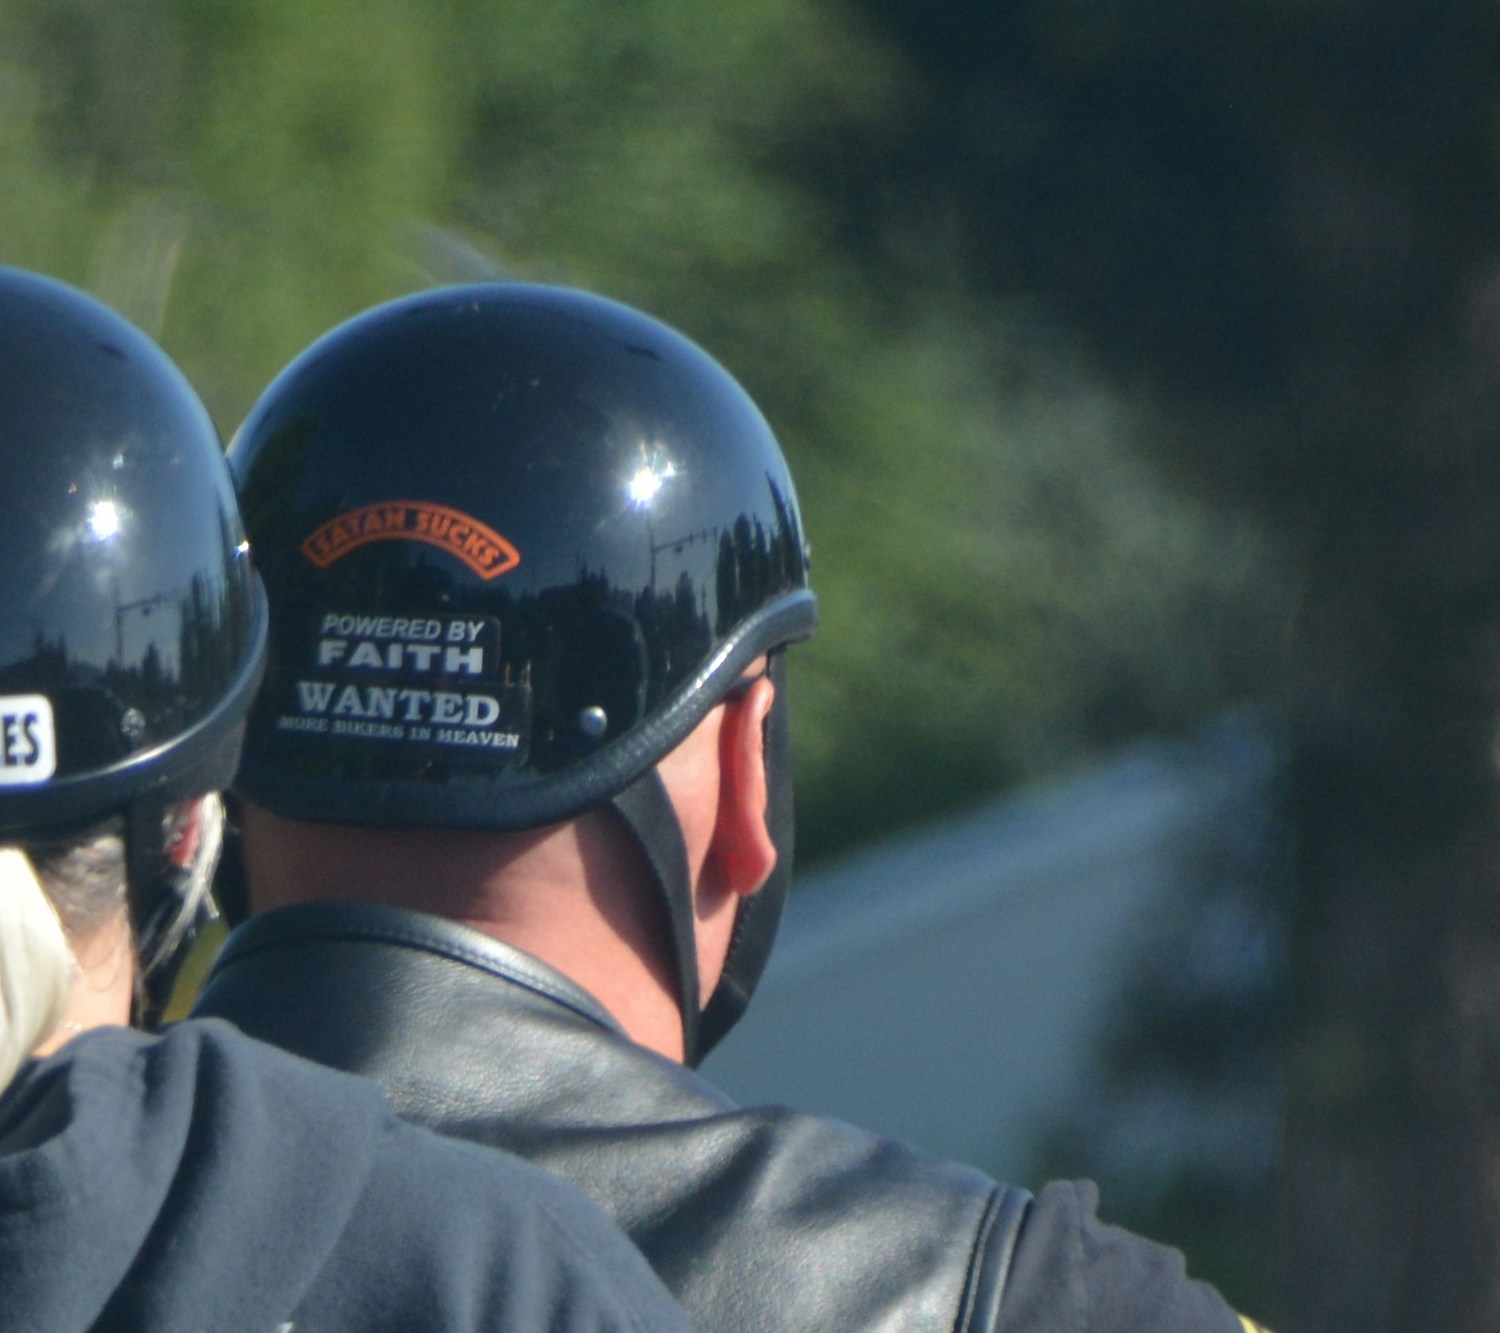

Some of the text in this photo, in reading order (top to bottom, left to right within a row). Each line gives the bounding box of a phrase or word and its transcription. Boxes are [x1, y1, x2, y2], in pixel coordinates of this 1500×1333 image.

[314, 508, 501, 568] SATAN SUCKS
[321, 613, 485, 643] POWERED BY
[316, 638, 484, 675] FAITH
[296, 681, 501, 727] WANTED
[278, 714, 521, 750] MORE BIKERS IN HEAVEN
